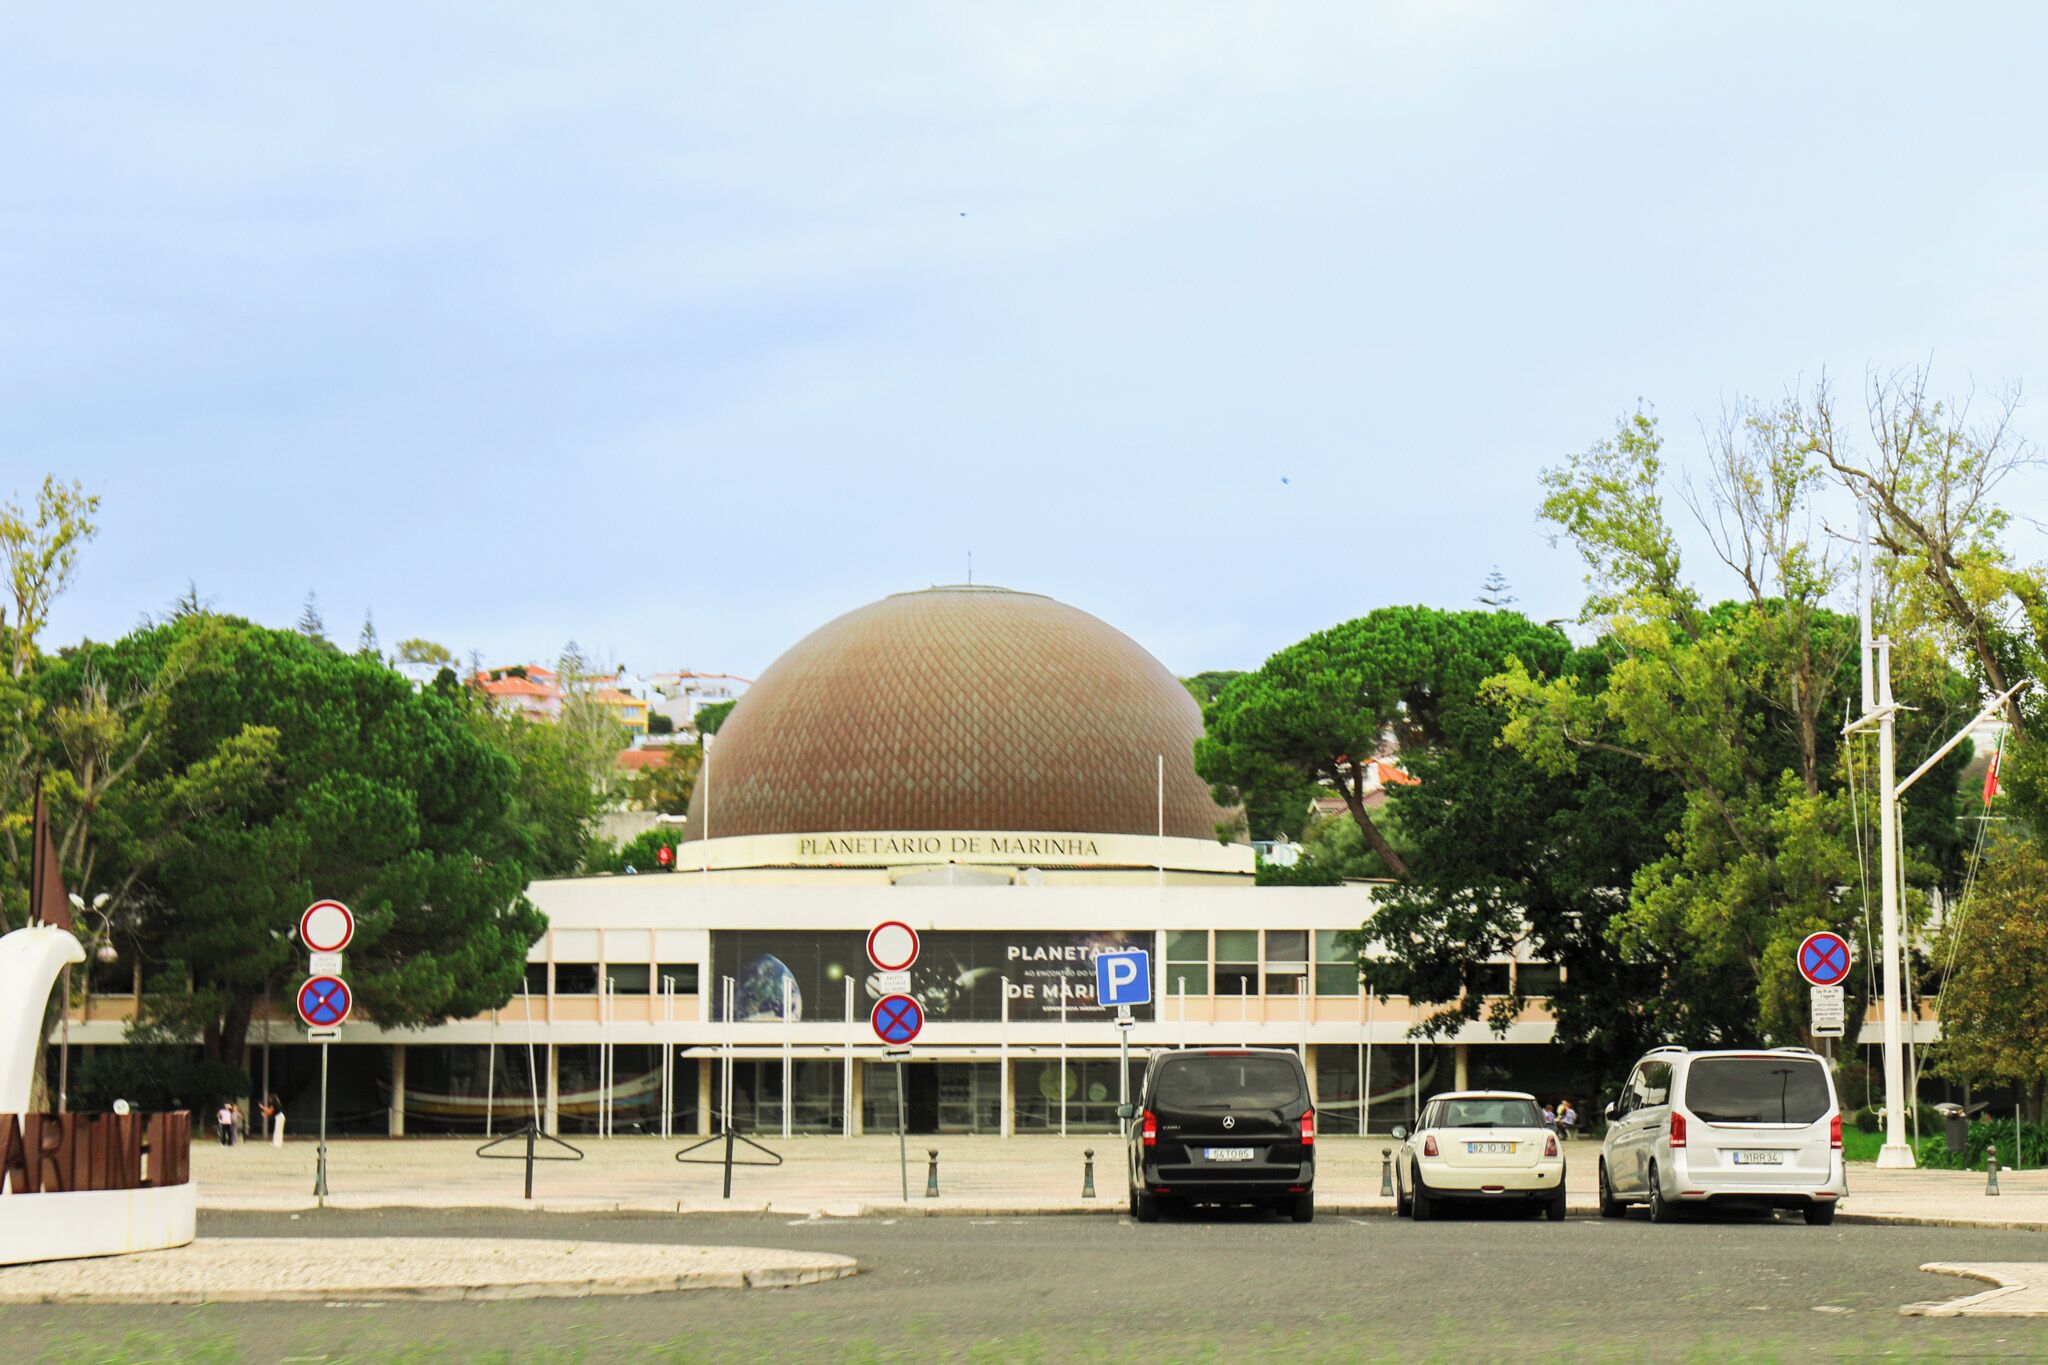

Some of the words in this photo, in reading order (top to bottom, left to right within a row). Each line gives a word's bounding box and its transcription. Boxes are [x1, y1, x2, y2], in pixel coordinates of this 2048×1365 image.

[800, 834, 941, 855] PLANETÁRIO
[951, 837, 981, 852] DE
[991, 837, 1099, 856] MARINHA
[1007, 943, 1140, 961] PLANETÁ
[1107, 957, 1137, 1001] P
[1008, 984, 1035, 999] DE
[1042, 984, 1096, 999] MARI
